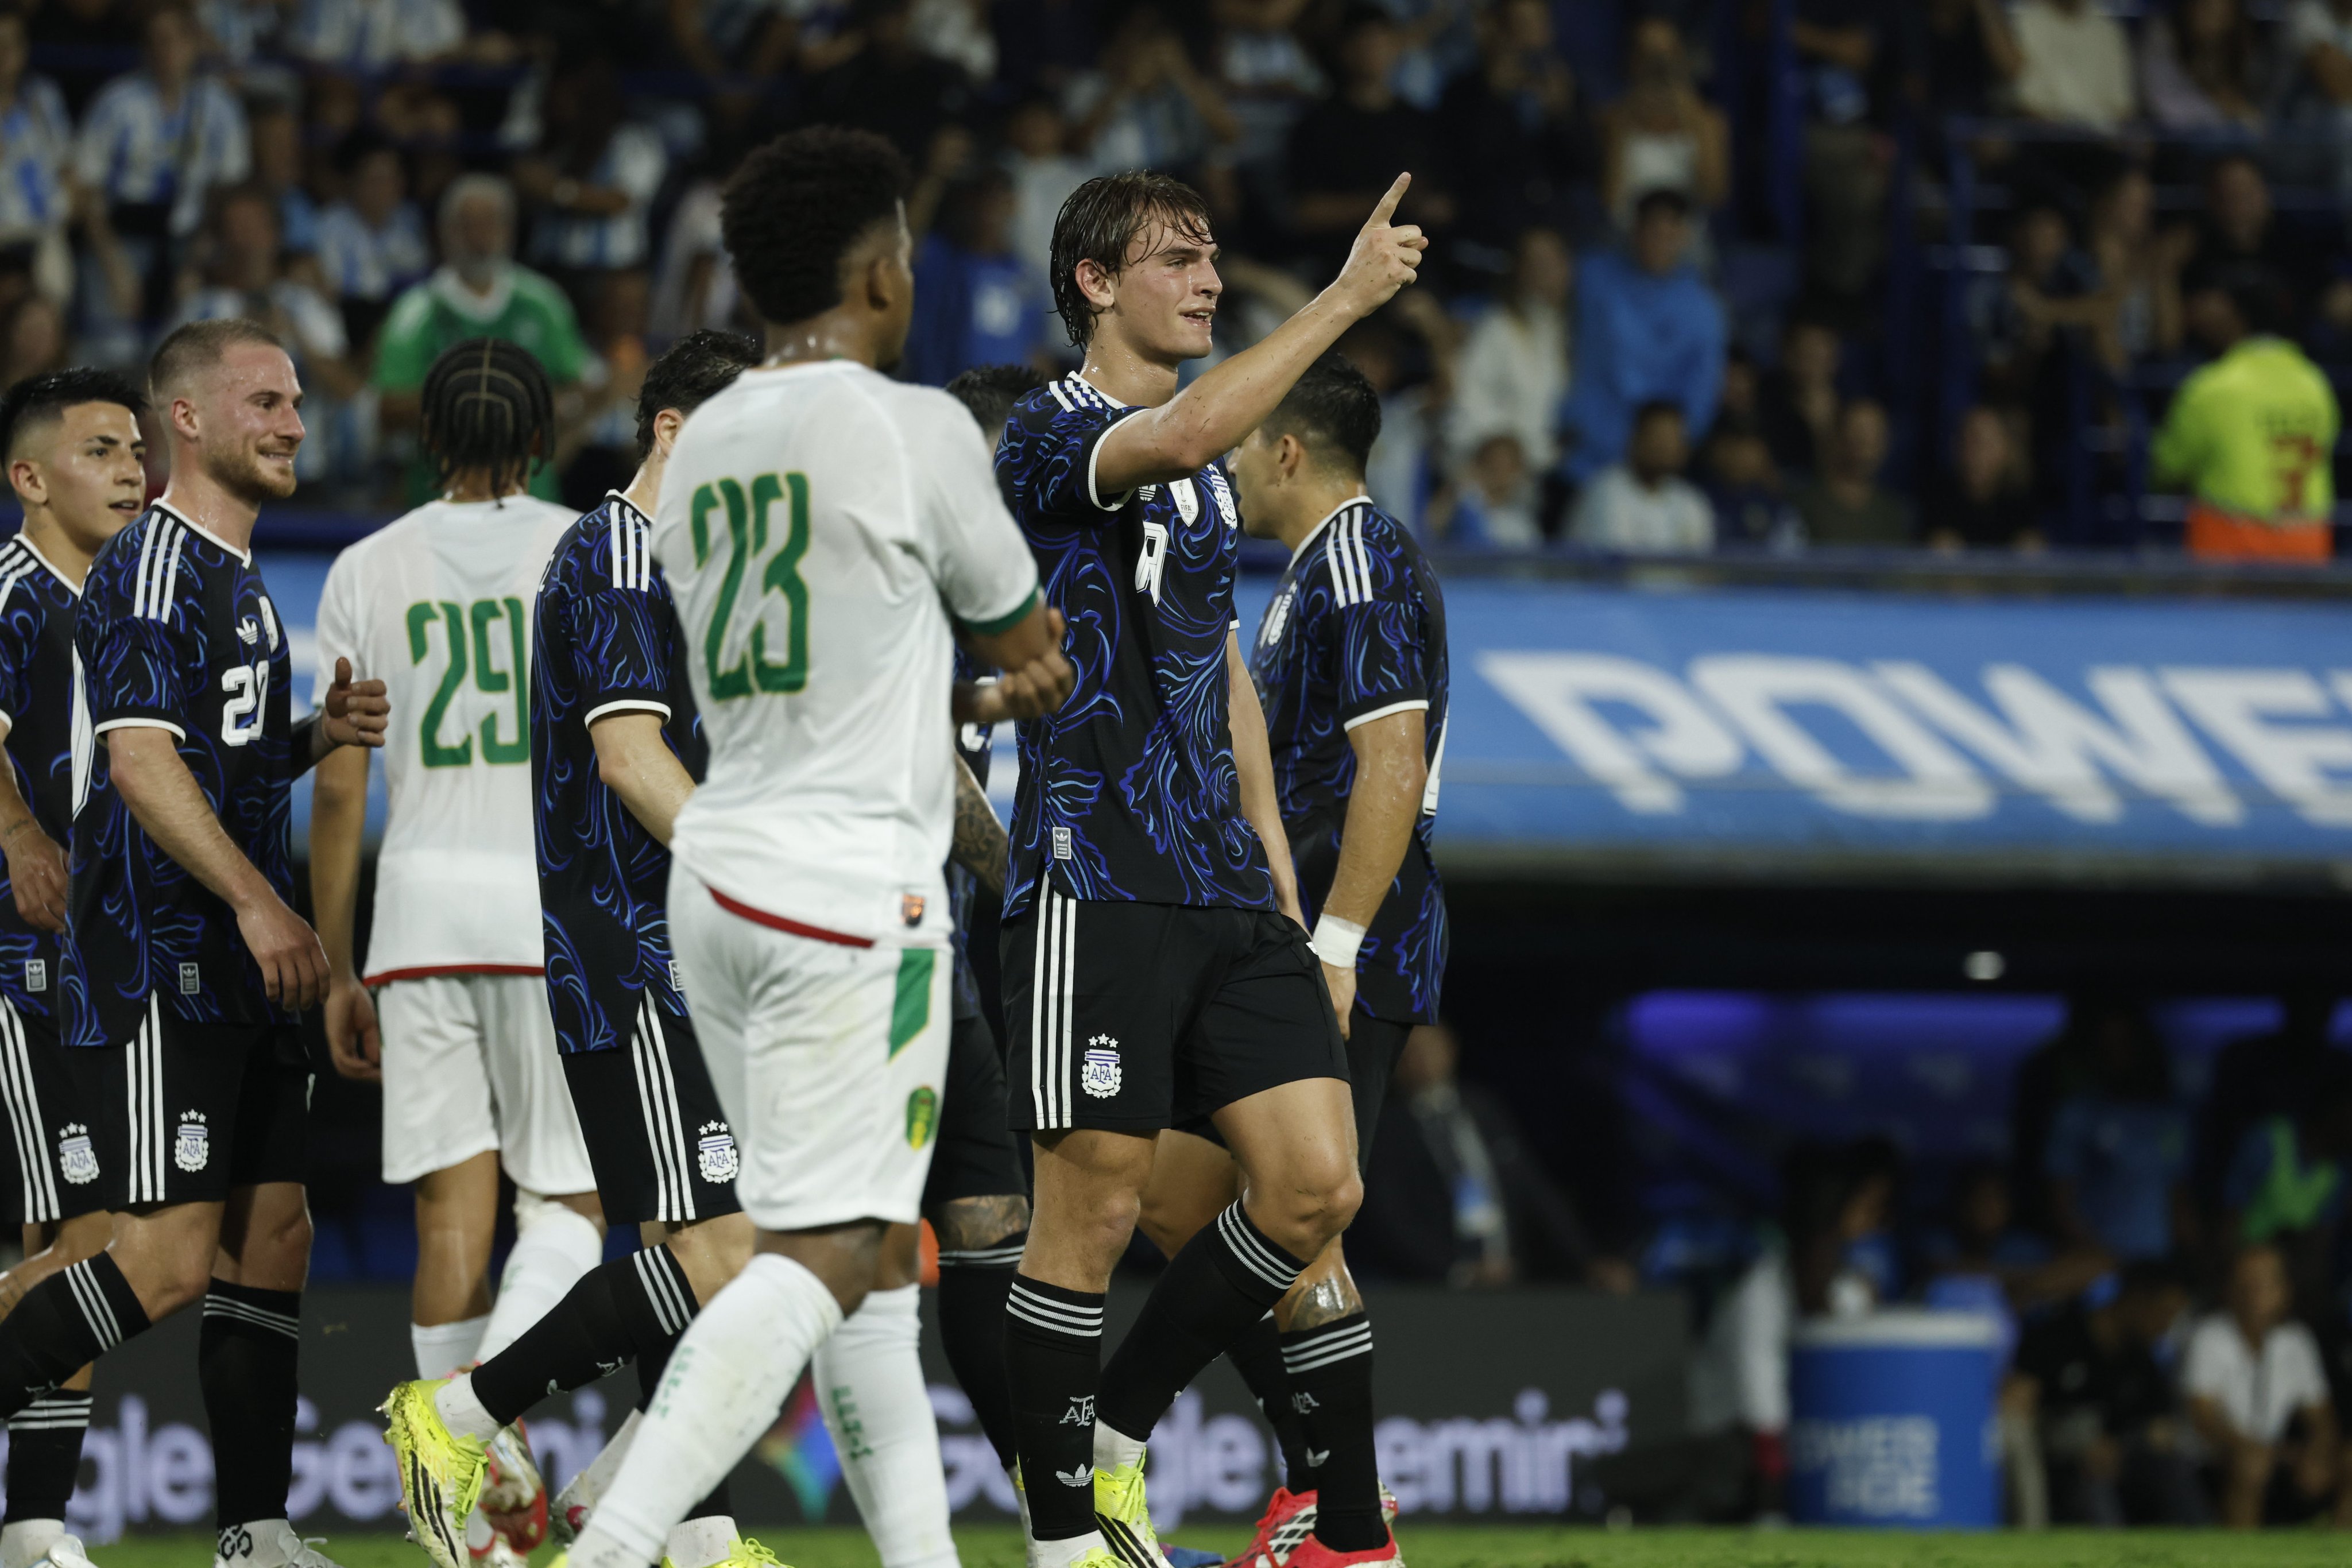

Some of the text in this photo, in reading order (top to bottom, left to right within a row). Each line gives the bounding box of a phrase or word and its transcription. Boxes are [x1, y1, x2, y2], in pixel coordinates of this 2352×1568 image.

[691, 473, 810, 701] 23
[407, 597, 532, 768] 29
[1473, 650, 2352, 826] POWE
[1090, 1062, 1113, 1085] AFA
[708, 1148, 730, 1169] AFA
[0, 1393, 217, 1547] gle
